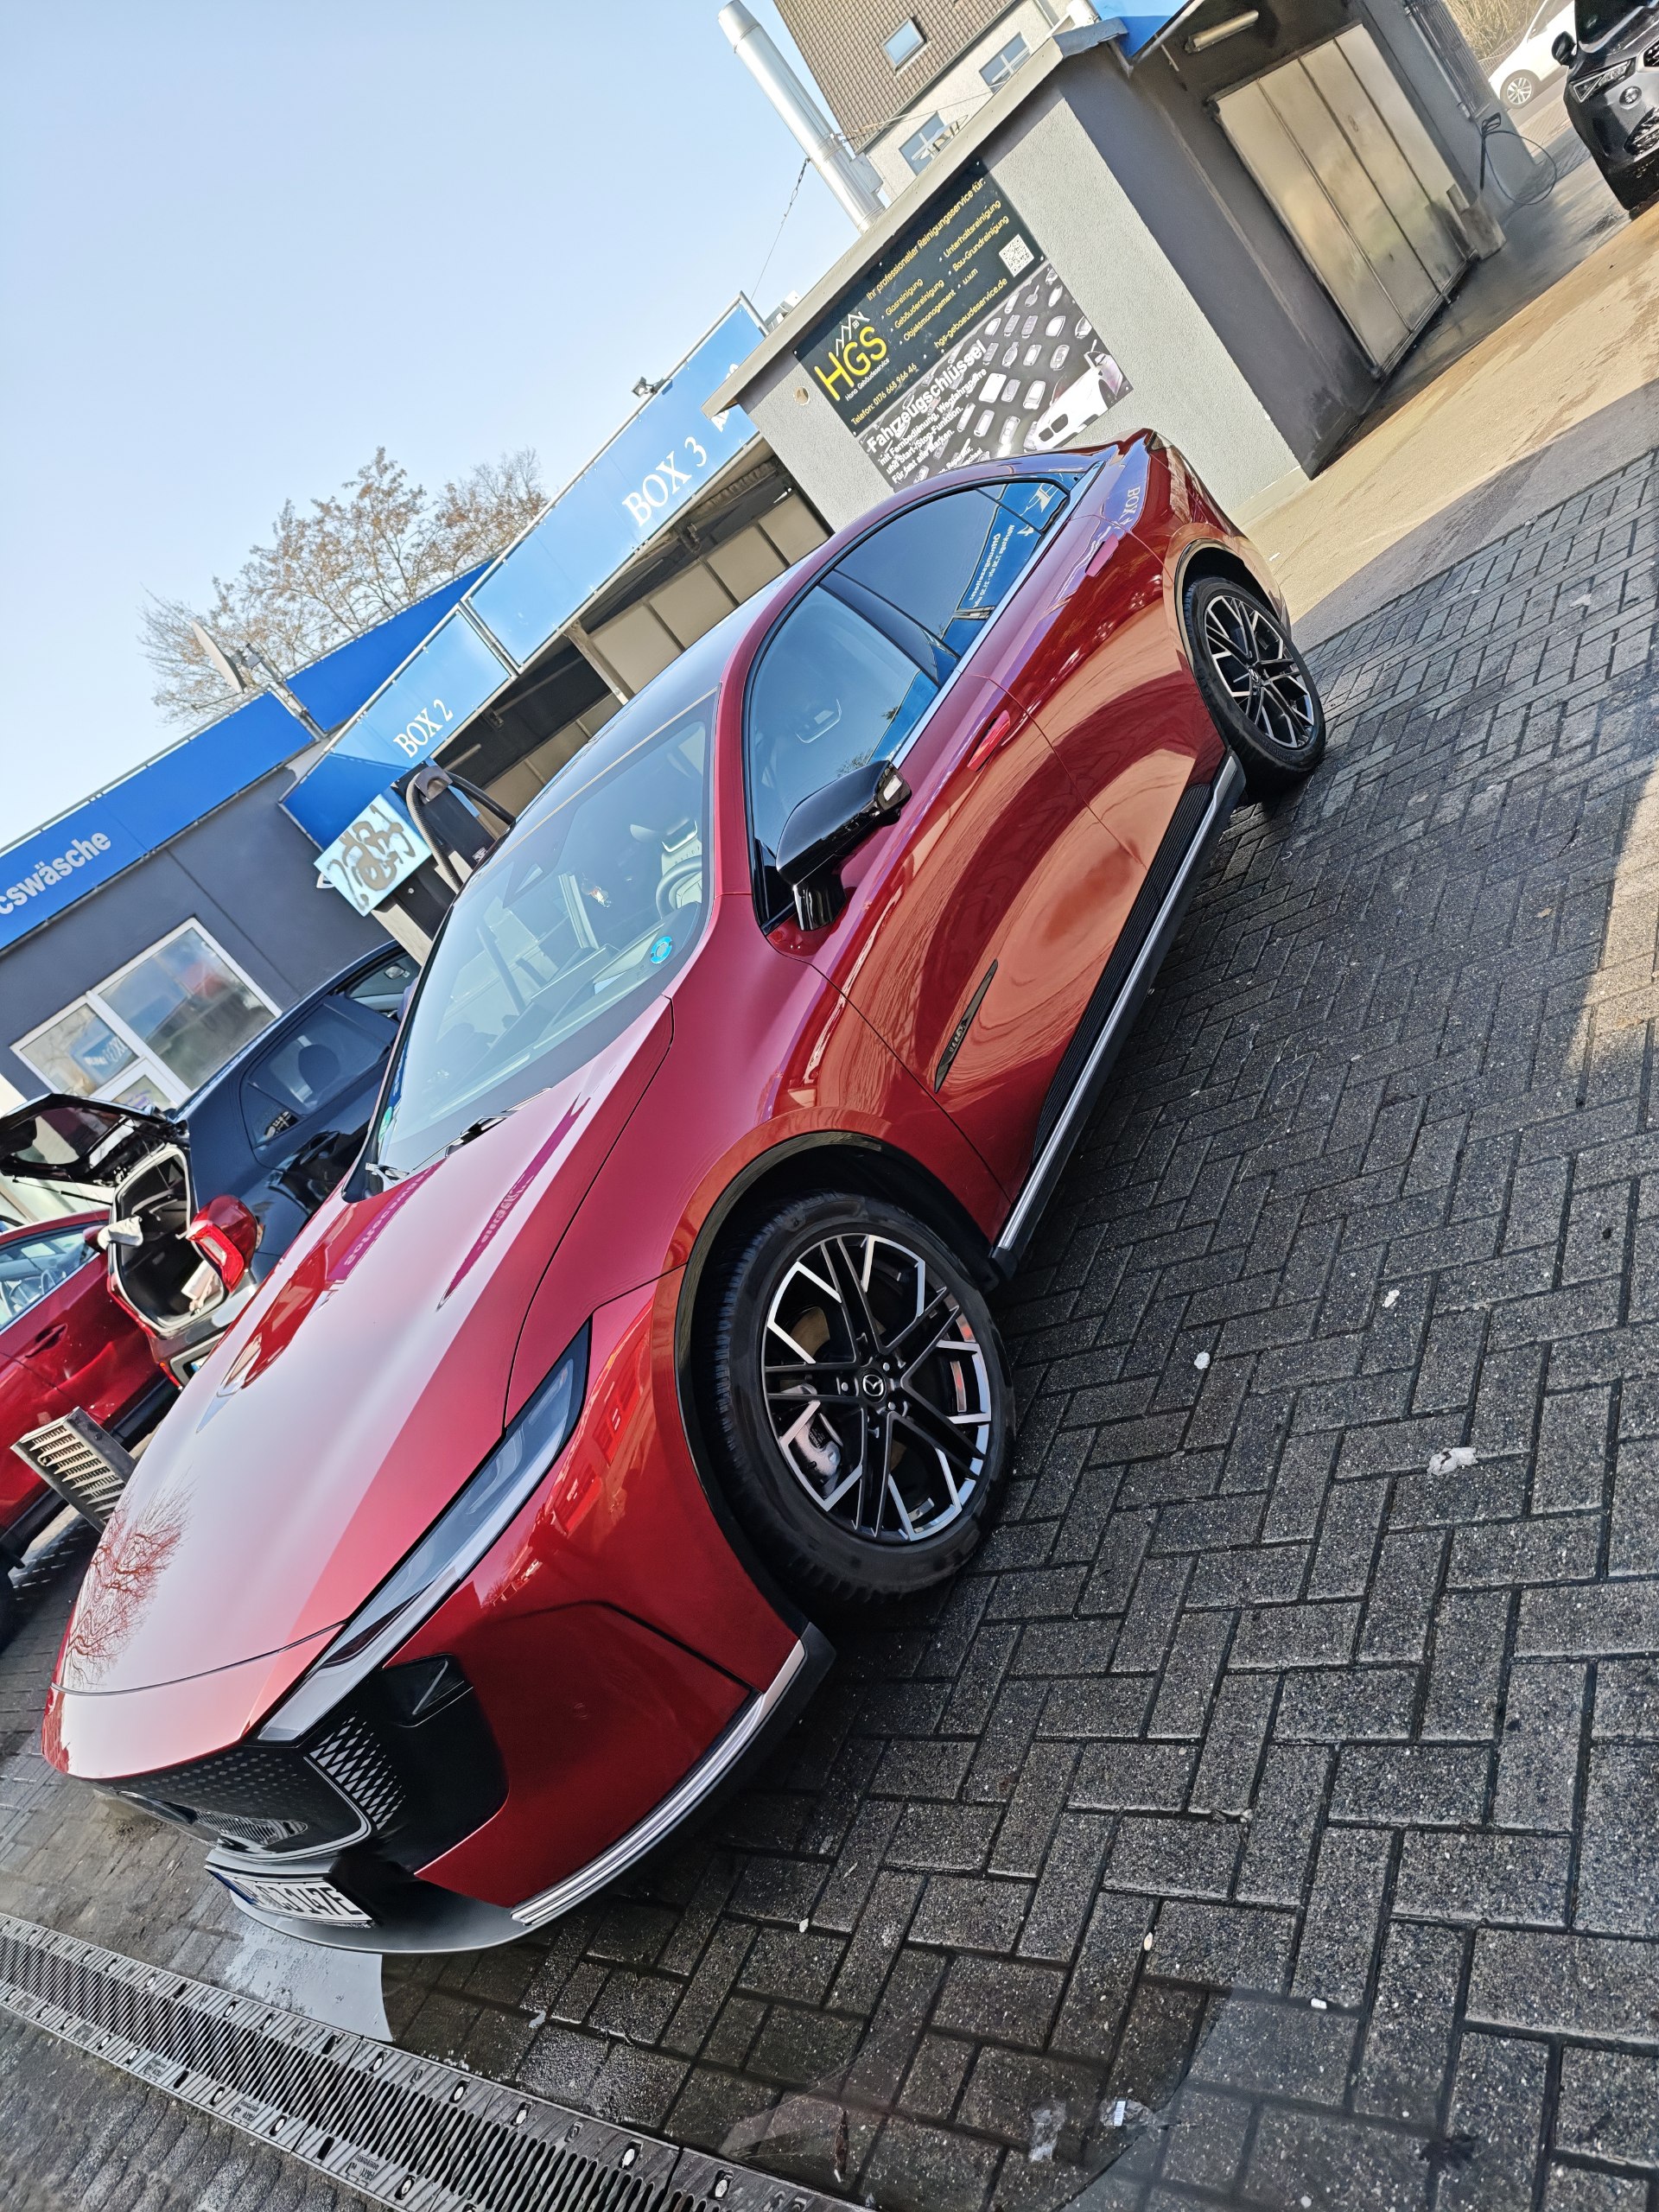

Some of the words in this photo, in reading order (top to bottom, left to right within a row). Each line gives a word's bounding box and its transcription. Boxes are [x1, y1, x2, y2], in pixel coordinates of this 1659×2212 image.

[866, 289, 877, 301] Ihr
[876, 245, 918, 294] professioneller
[917, 189, 974, 249] Reinigungsservice
[944, 200, 1001, 257] Unterhaltsreinigung
[952, 215, 1009, 272] Bau-Grundreinigung
[886, 278, 924, 316] Glasreinigung
[894, 279, 945, 328] Gebäudereinigung
[903, 289, 957, 341] Objektmanagement
[934, 277, 1008, 348] hgs-gebaeudeservice.de
[814, 326, 887, 401] HGS
[851, 403, 875, 425] Telefon:
[873, 391, 887, 406] 0176
[886, 380, 898, 394] 668
[896, 372, 909, 386] 966
[908, 363, 918, 374] 46
[866, 339, 987, 454] Fahrzeugschlüssel
[622, 450, 692, 527] BOX
[684, 436, 707, 467] 3
[878, 451, 892, 467] mit
[892, 470, 905, 484] Für
[393, 707, 443, 759] BOX
[433, 699, 454, 722] 2
